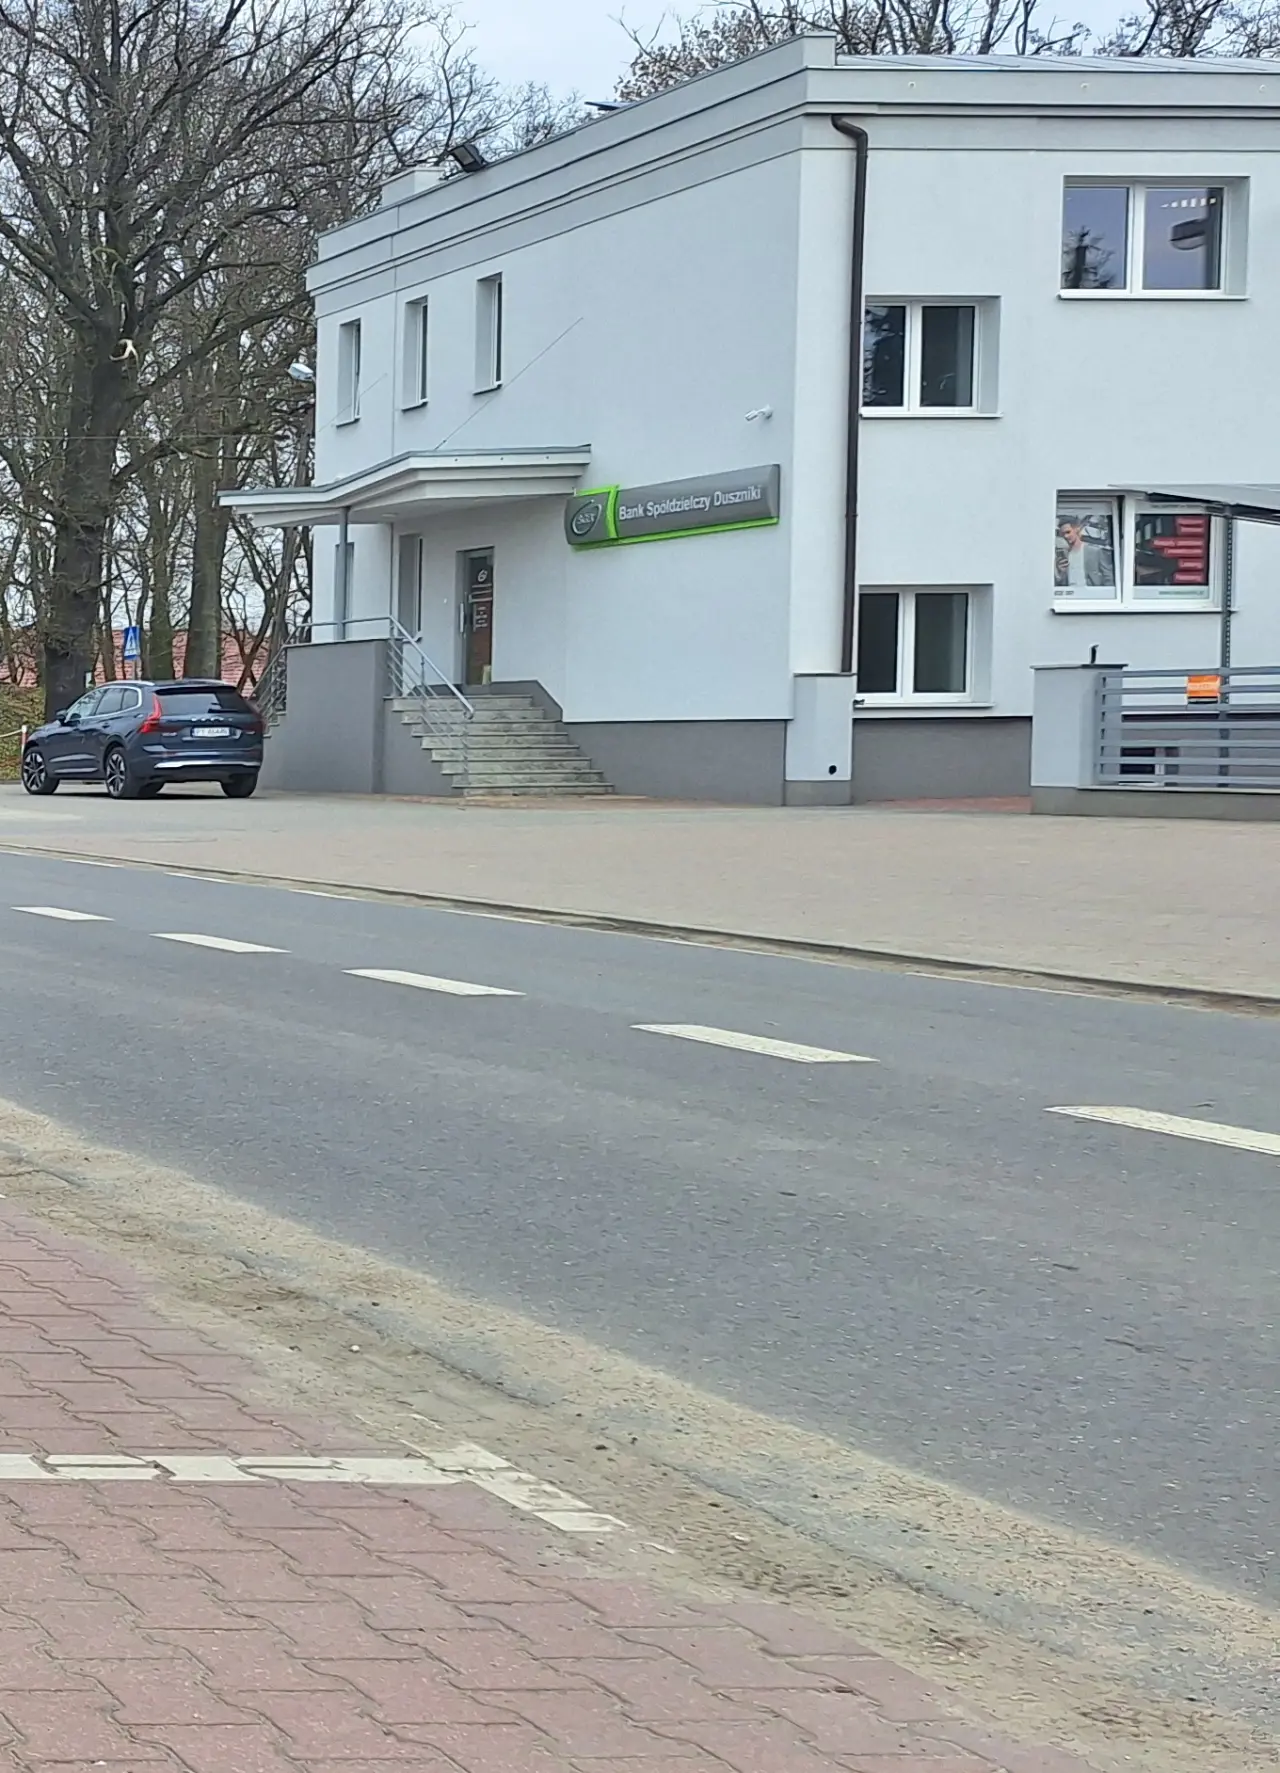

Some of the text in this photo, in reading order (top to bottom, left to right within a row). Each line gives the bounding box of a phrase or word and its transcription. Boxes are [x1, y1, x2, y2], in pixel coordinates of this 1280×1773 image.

[619, 485, 761, 520] Bank Spółdzielczy Duszniki
